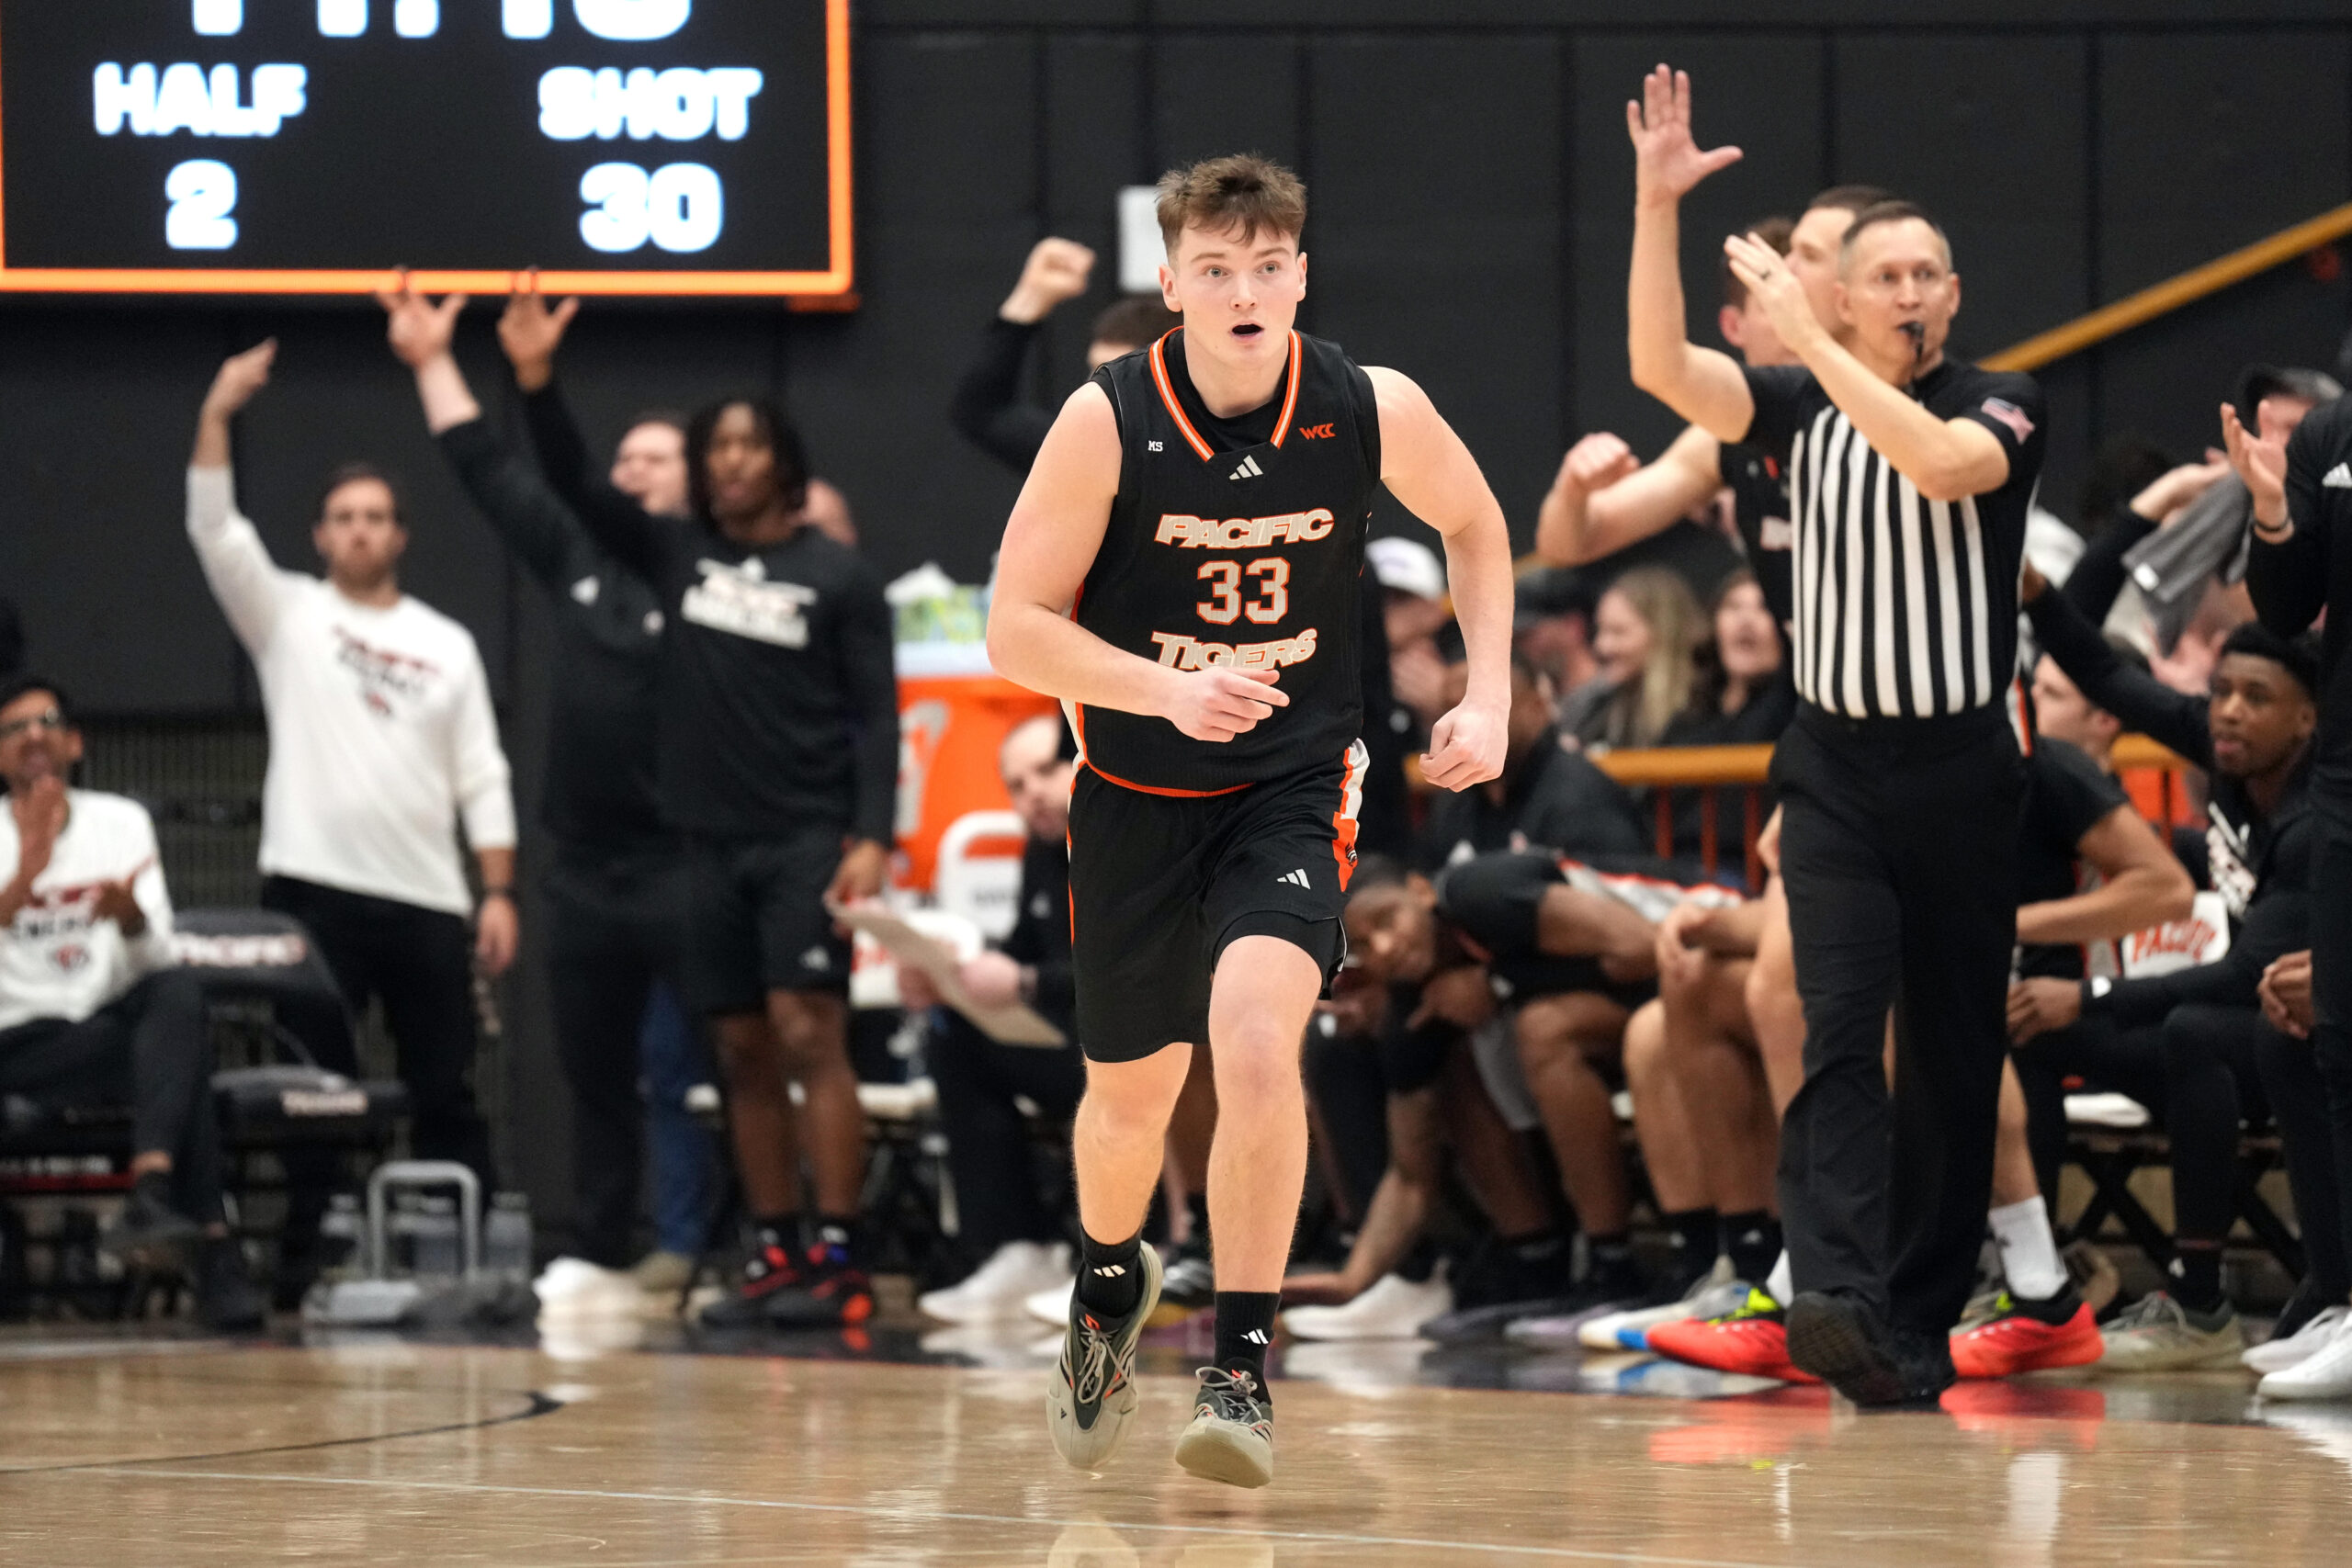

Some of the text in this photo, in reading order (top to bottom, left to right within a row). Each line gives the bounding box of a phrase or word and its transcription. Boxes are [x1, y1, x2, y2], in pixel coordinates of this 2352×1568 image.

[93, 62, 308, 138] HALF
[537, 65, 764, 141] SHOT
[164, 159, 239, 250] 2
[579, 162, 725, 254] 30
[1148, 440, 1164, 452] MS
[1299, 423, 1337, 440] WCC
[1154, 508, 1335, 549] PACIFIC
[1196, 557, 1291, 626] 33
[1151, 627, 1317, 672] TIGERS
